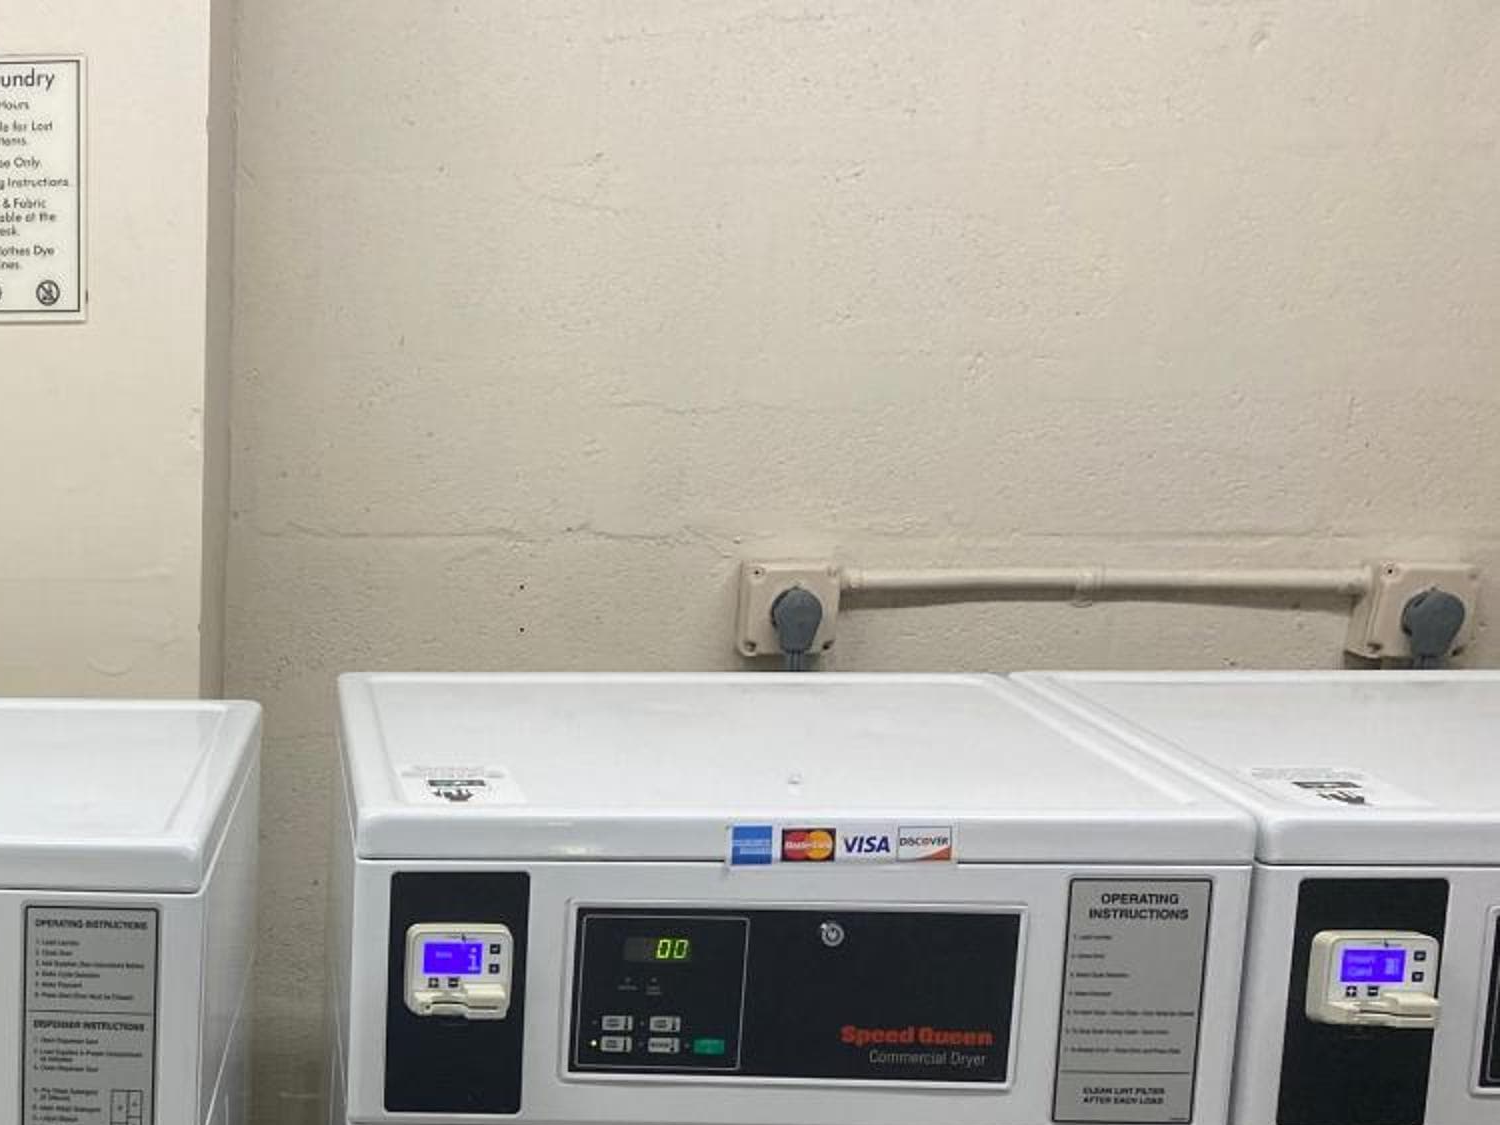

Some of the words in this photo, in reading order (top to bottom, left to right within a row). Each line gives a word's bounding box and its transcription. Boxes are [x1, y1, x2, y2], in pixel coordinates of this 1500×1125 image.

[12, 120, 27, 132] for
[31, 120, 53, 131] Lost
[2, 198, 11, 208] &
[13, 198, 47, 209] Fabric
[25, 212, 36, 222] at
[39, 211, 57, 222] the
[33, 244, 56, 256] Dye
[843, 835, 891, 853] VISA
[899, 837, 949, 847] DISCOVER
[1101, 893, 1179, 905] OPERATING
[1089, 908, 1189, 920] INSTRUCTIONS
[840, 1025, 915, 1047] Speed
[917, 1026, 995, 1046] Queen
[869, 1049, 948, 1065] Commercial
[951, 1052, 986, 1069] Dryer
